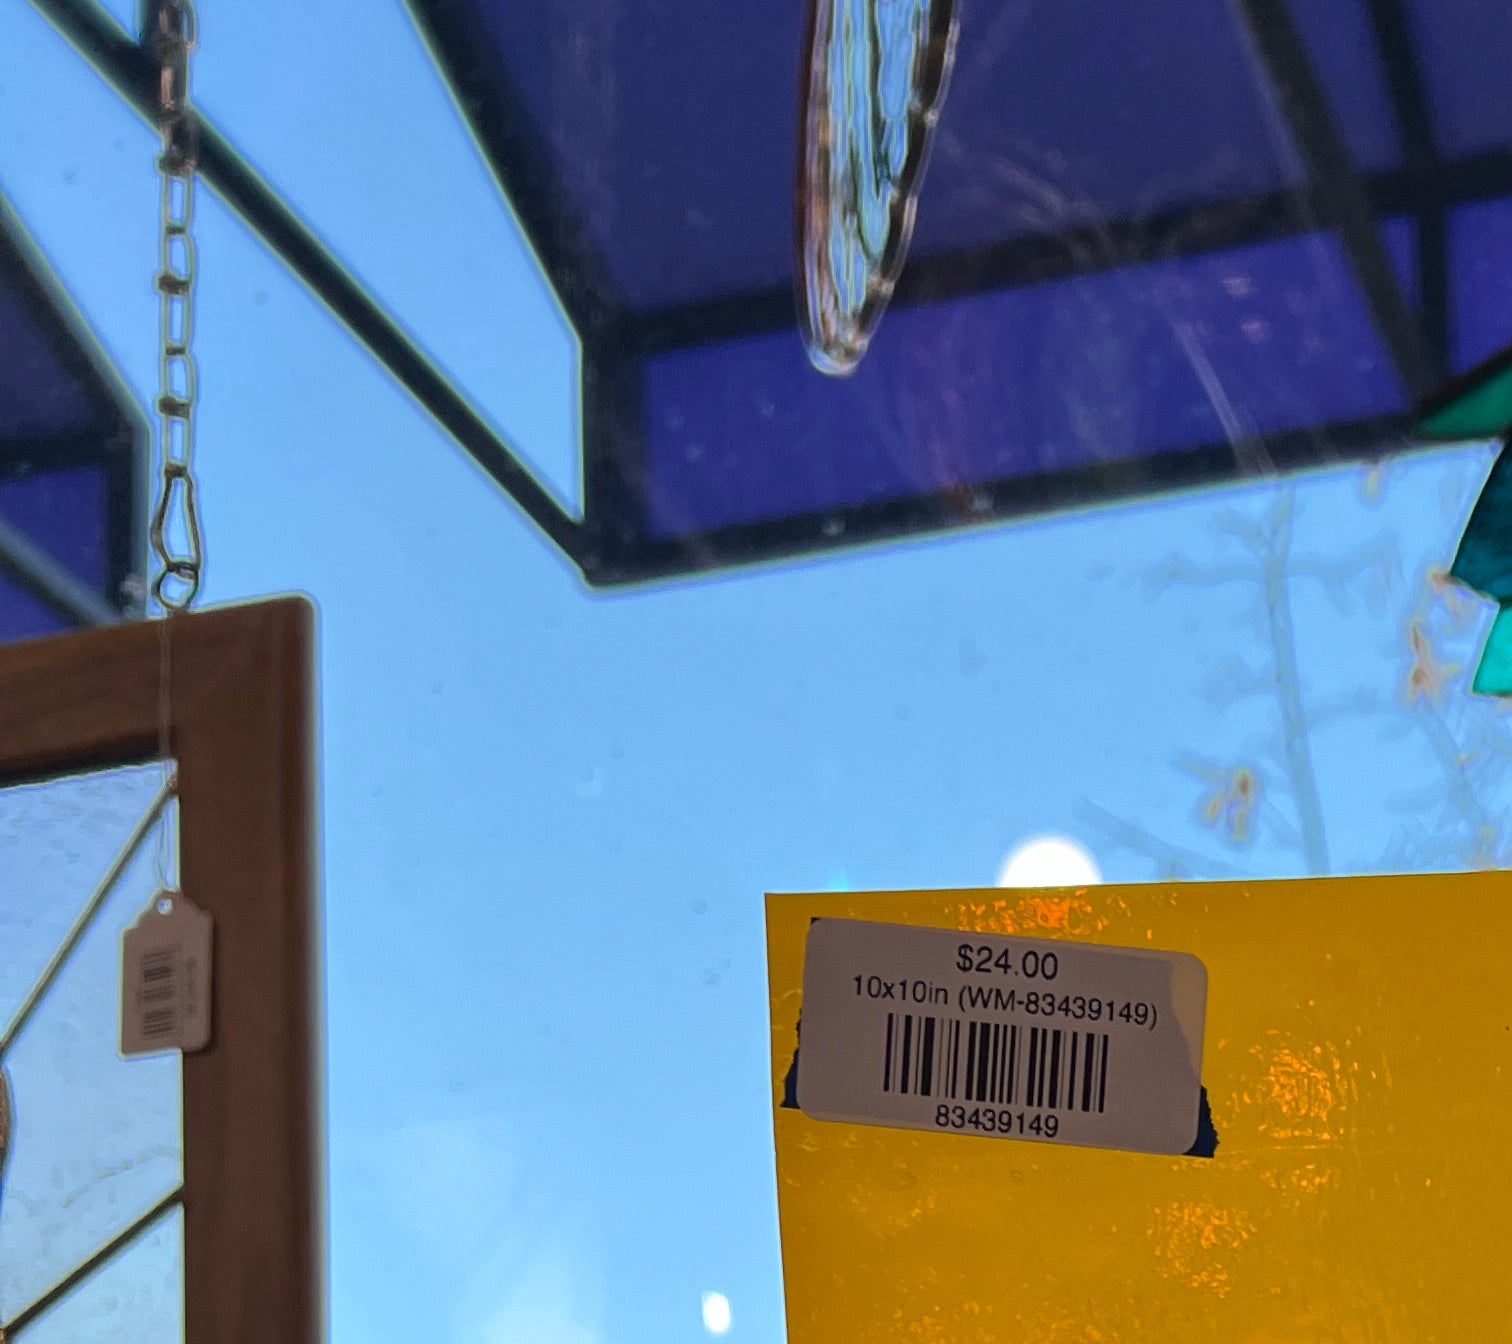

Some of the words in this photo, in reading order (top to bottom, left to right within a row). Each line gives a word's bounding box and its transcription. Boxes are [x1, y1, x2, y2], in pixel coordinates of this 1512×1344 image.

[956, 943, 1059, 980] $24.00
[853, 975, 948, 1005] 10x10in
[958, 985, 1158, 1031] (WM-83439149)
[935, 1104, 1059, 1138] 83439149
